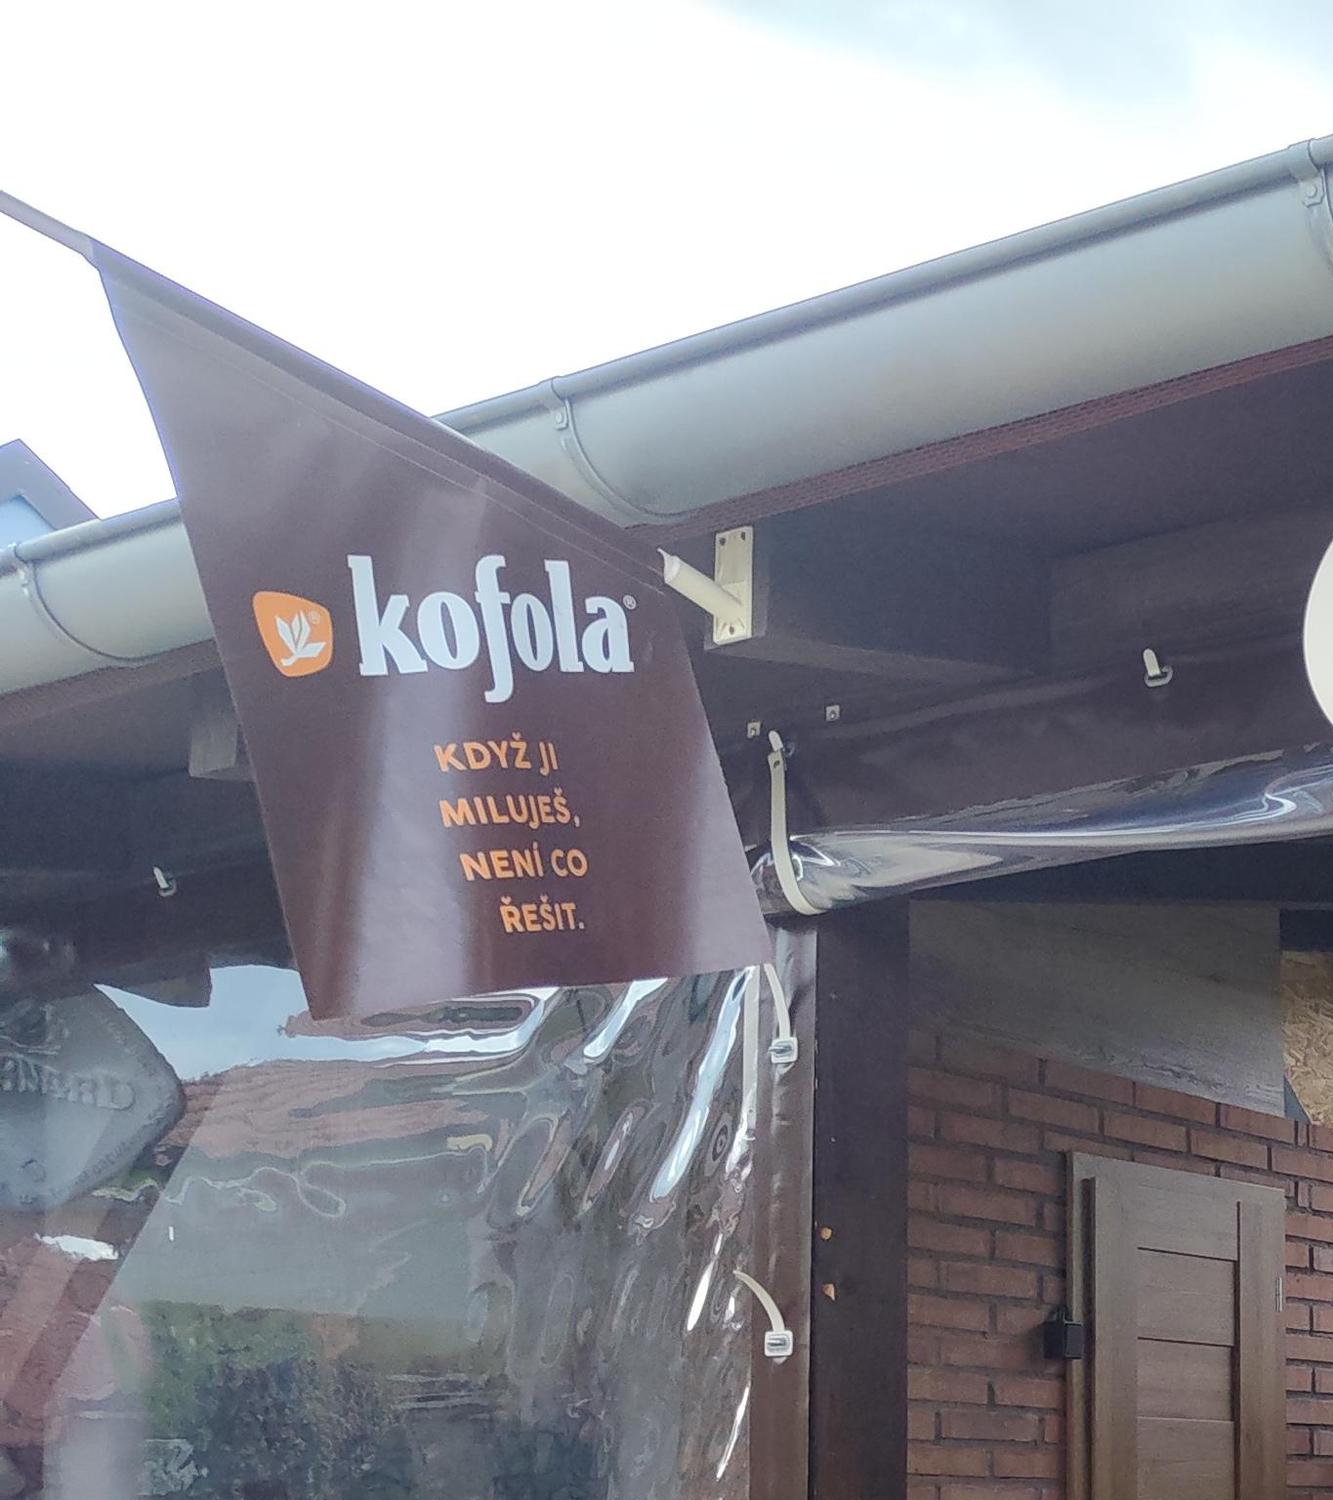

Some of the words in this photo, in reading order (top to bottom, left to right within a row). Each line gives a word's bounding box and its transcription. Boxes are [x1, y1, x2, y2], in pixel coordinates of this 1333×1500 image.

[347, 554, 634, 703] kofola
[434, 732, 531, 773] KDYŽ
[540, 742, 559, 776] JI
[440, 788, 580, 829] MILUJEŠ,
[460, 842, 546, 881] NENÍ
[550, 848, 589, 878] CO
[499, 895, 585, 935] ŘEŠIT.
